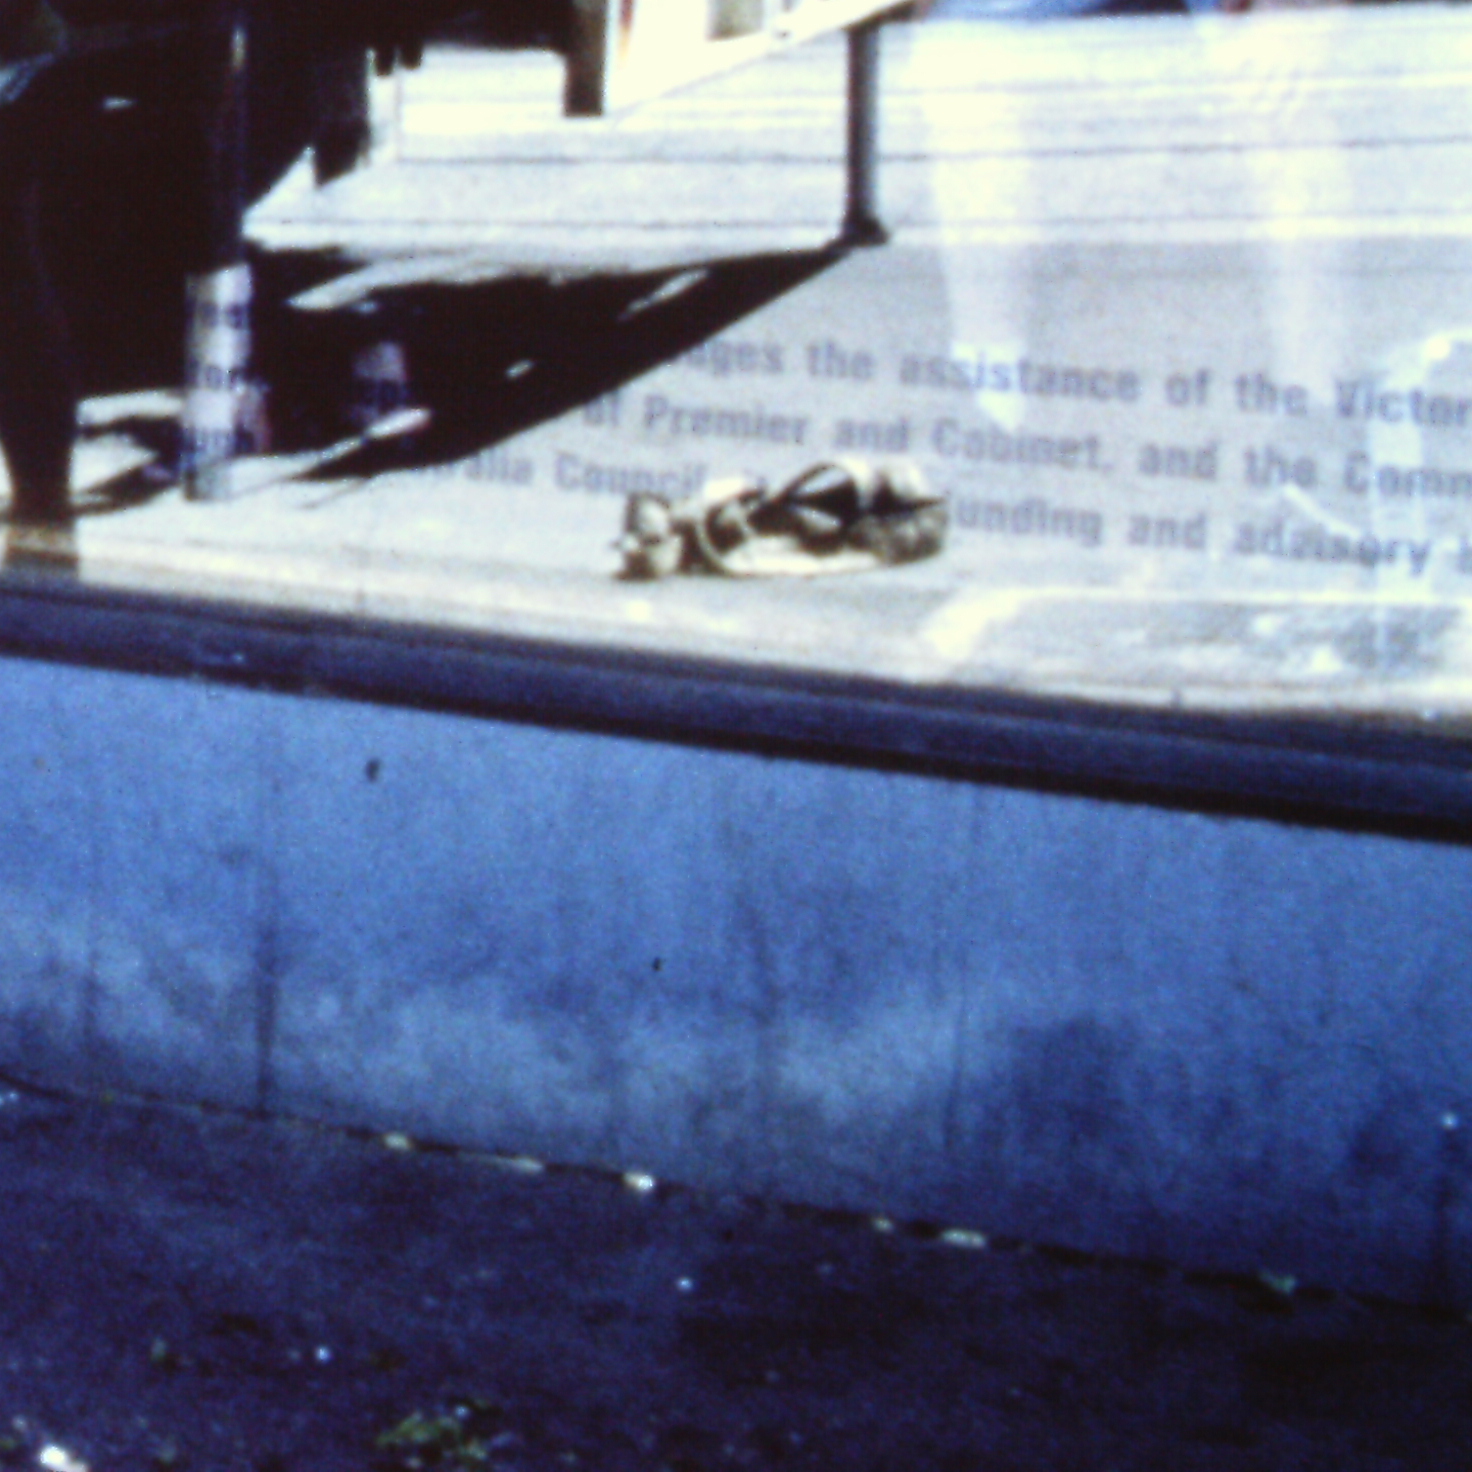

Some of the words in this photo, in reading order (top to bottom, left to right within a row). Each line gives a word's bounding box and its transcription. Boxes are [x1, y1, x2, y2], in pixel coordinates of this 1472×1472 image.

[807, 340, 872, 381] the
[898, 356, 1138, 403] assistance
[1166, 369, 1211, 408] of
[1233, 373, 1307, 416] the
[642, 394, 808, 446] Premier
[832, 413, 910, 453] and
[1140, 443, 1216, 481] and
[1244, 447, 1316, 488] the
[1128, 513, 1206, 551] and
